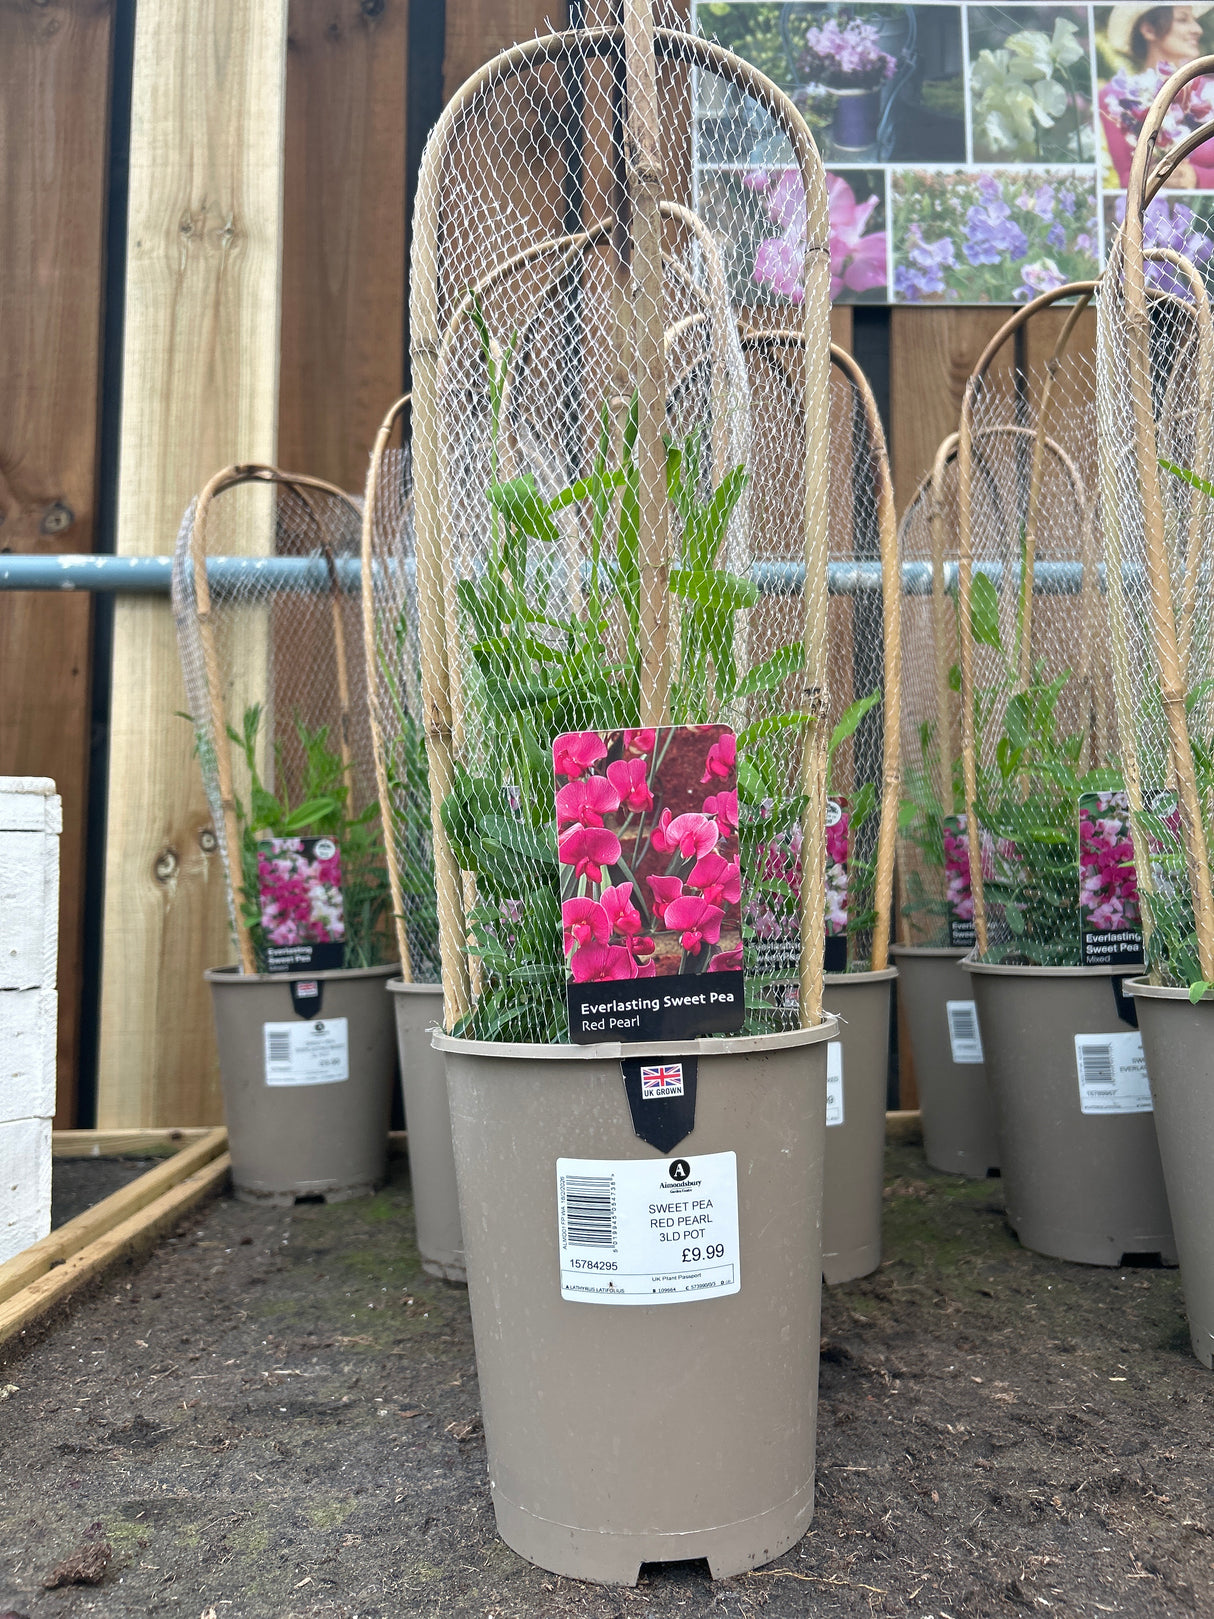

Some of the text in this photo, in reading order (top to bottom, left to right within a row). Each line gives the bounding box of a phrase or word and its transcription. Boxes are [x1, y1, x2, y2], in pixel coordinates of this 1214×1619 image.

[1086, 932, 1141, 944] Everlasting
[1086, 942, 1139, 954] Sweet Pea
[1086, 955, 1111, 964] Mixed
[581, 992, 735, 1015] Everlasting Sweet Pea
[582, 1015, 640, 1031] Red Pearl
[644, 1086, 682, 1098] UK GROWN
[660, 1179, 702, 1189] Almondsbury
[648, 1199, 714, 1214] SWEET PEA
[650, 1213, 713, 1229] RED PEARL
[659, 1228, 706, 1242] 3LD POT
[681, 1243, 725, 1263] £9.99
[570, 1259, 618, 1271] 15784295
